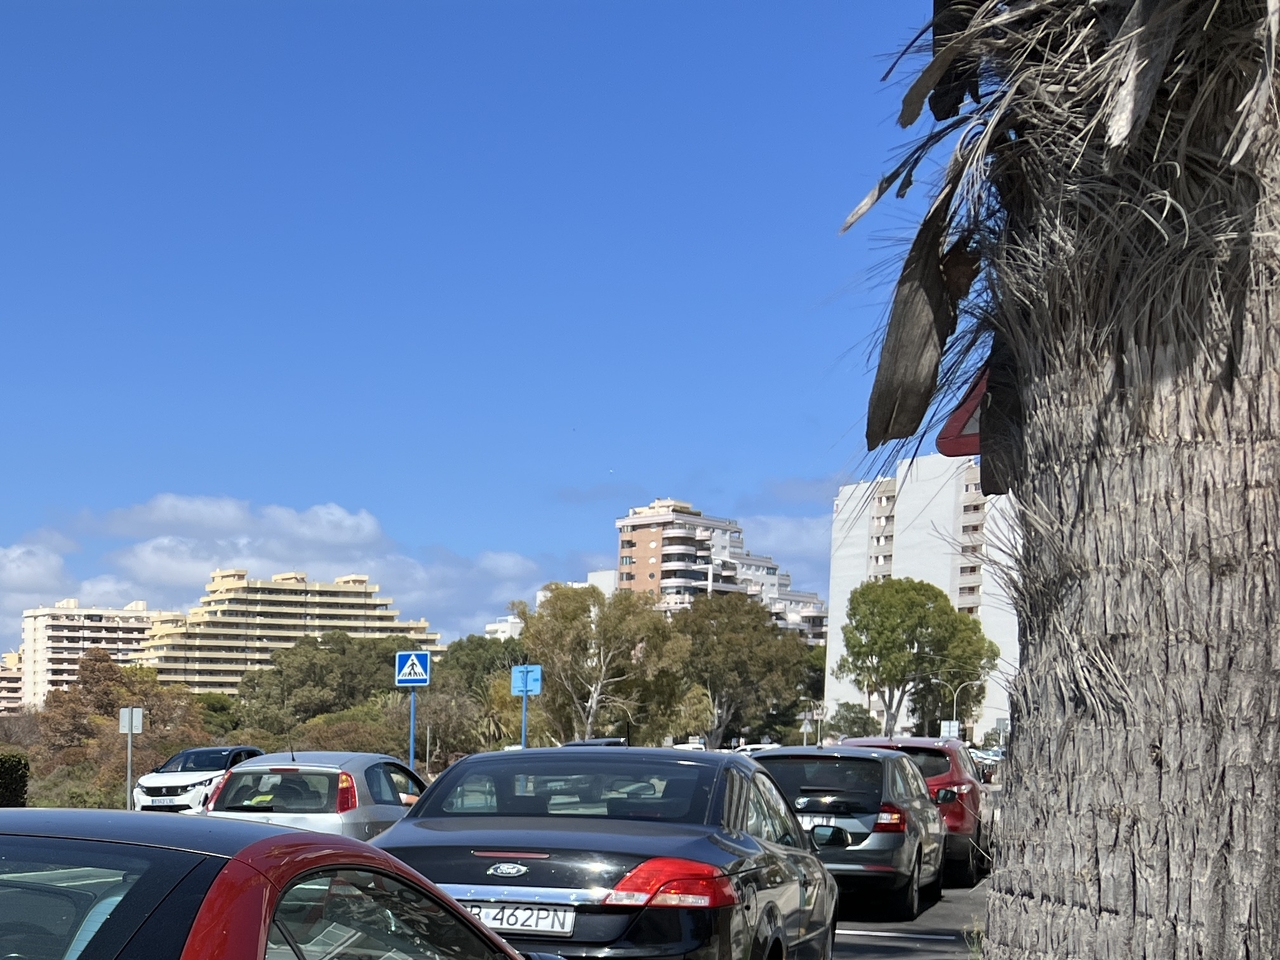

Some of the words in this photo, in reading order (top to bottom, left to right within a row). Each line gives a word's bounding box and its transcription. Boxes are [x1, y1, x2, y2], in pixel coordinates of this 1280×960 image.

[496, 863, 519, 874] Ford
[461, 903, 482, 921] B
[491, 905, 568, 930] 462PN
